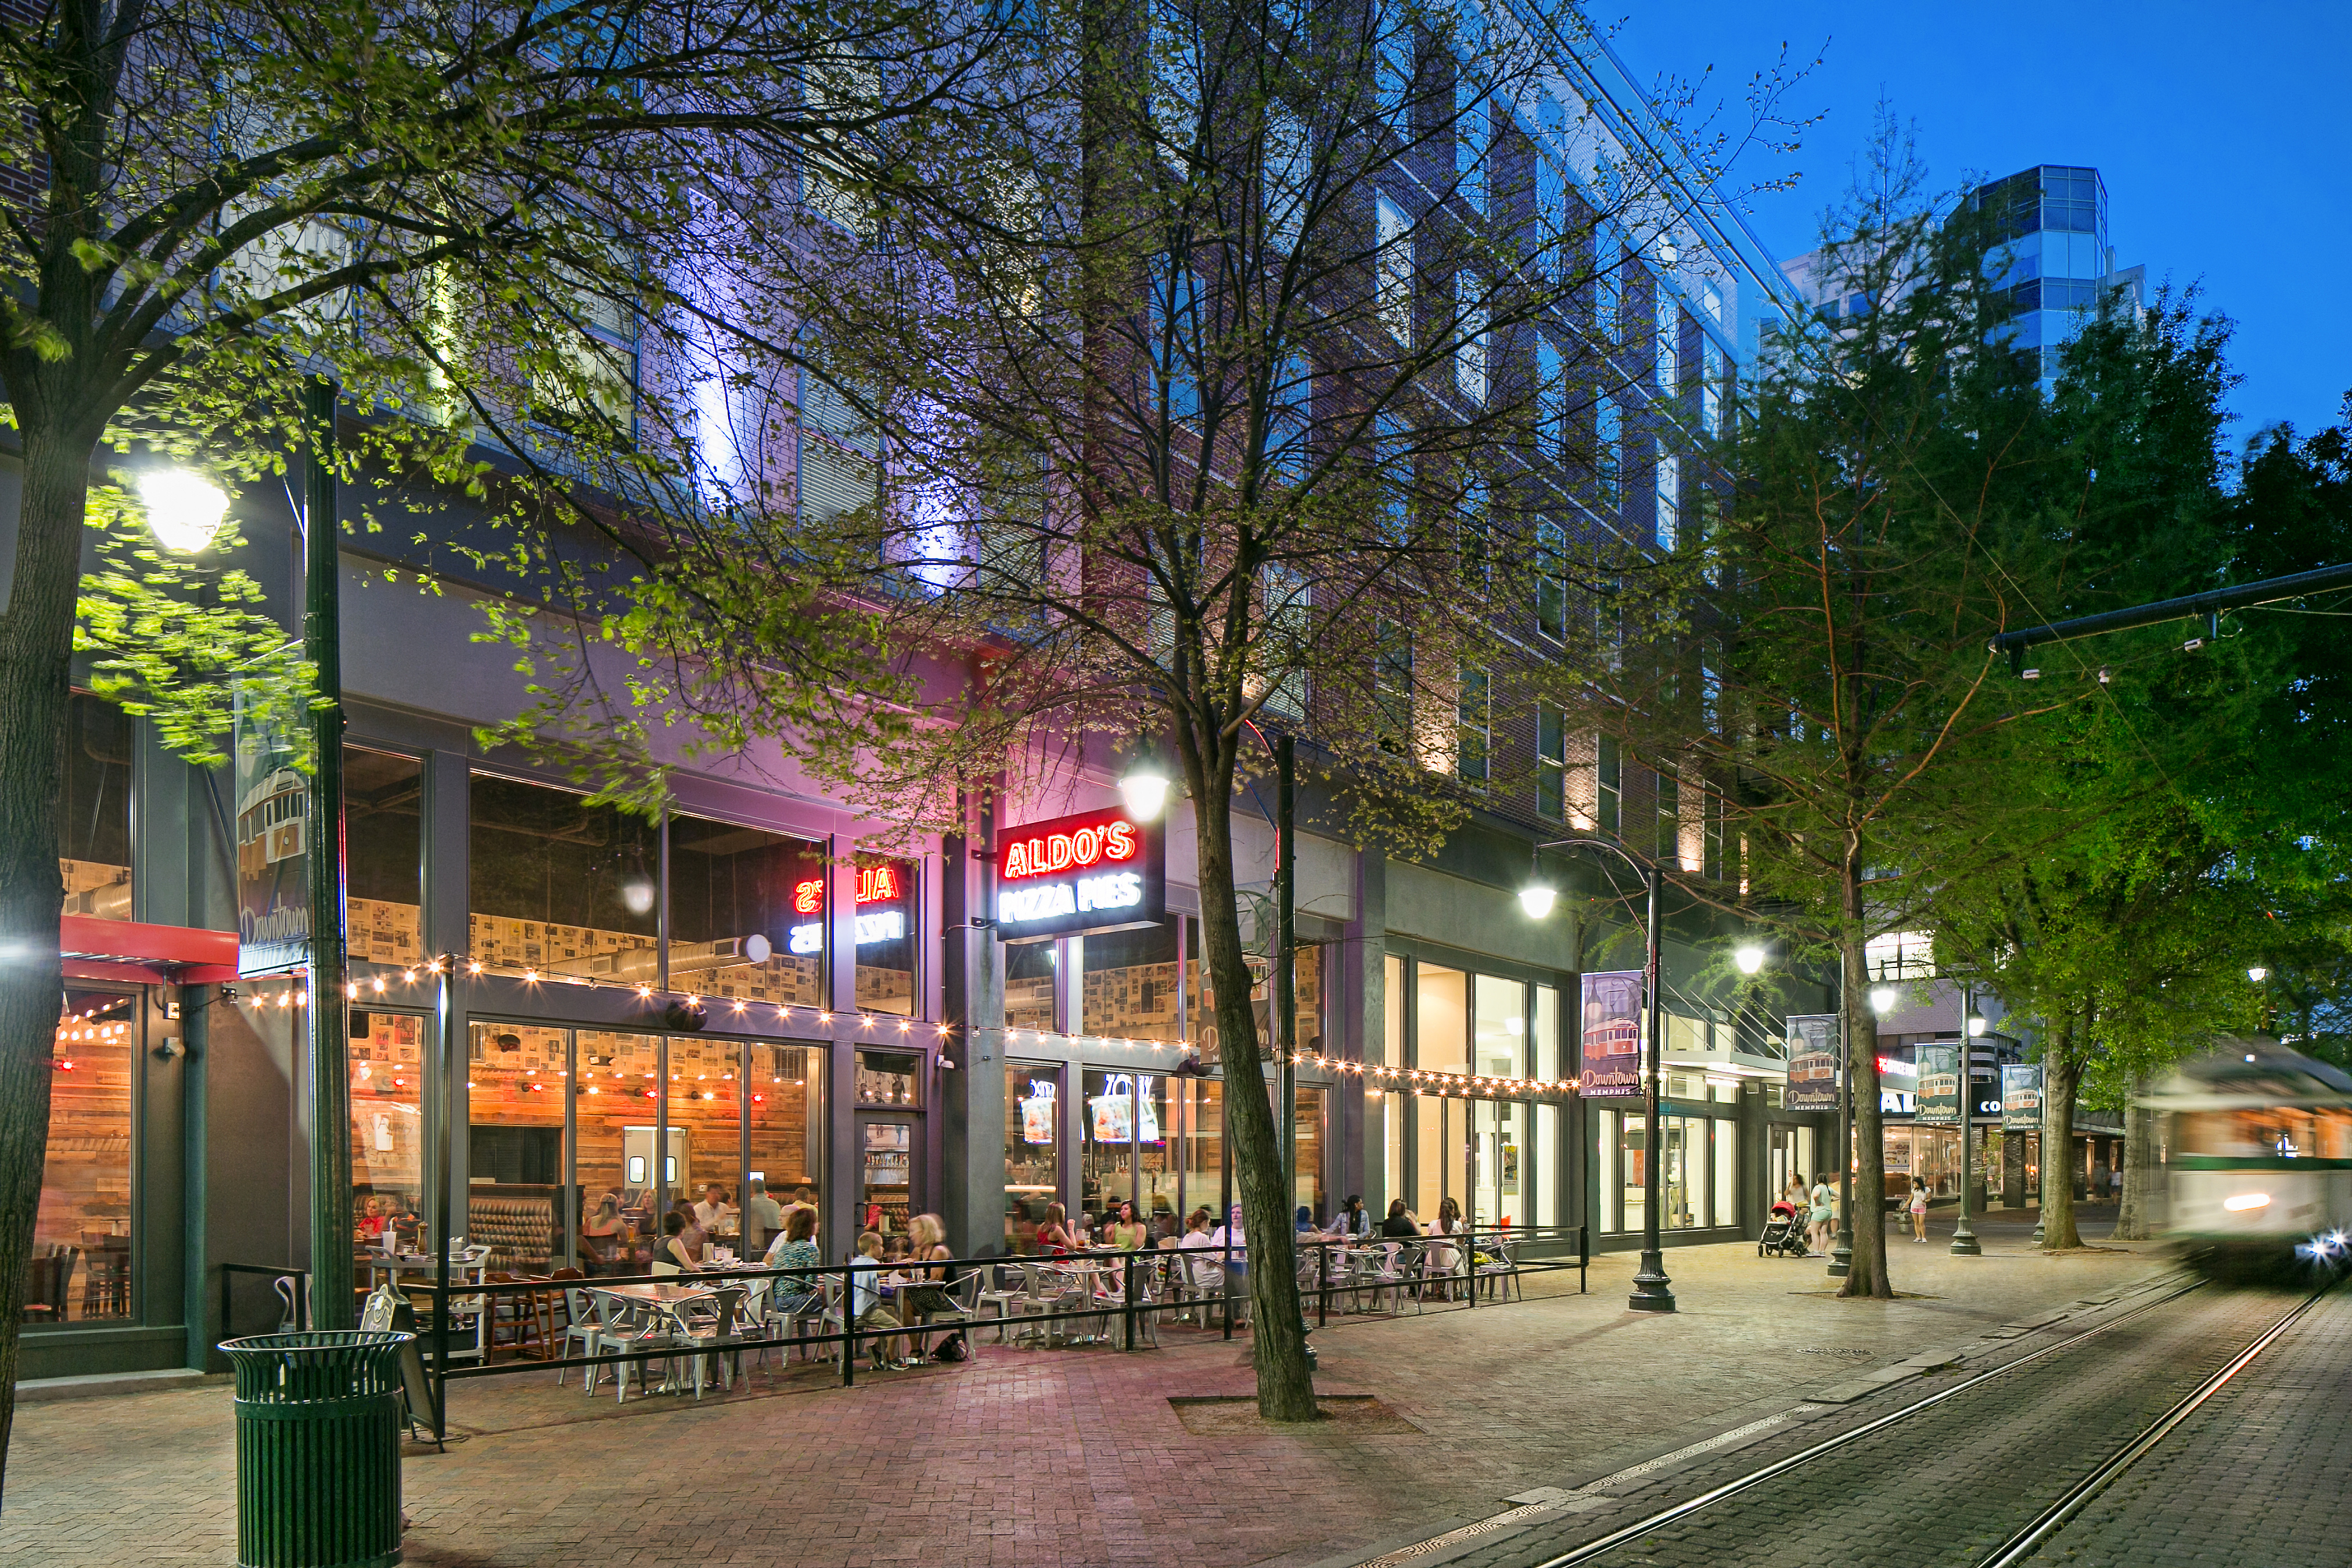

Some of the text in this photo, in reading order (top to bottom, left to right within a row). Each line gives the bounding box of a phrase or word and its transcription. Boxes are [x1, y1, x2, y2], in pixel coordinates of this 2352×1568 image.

[1005, 821, 1135, 879] ALDO'S
[999, 872, 1141, 923] PIZZA PIES
[240, 893, 309, 945] Downtown
[1583, 1066, 1638, 1087] Downtown
[1789, 1088, 1834, 1104] Downtown
[1880, 1093, 1916, 1113] AL
[1917, 1102, 1957, 1116] Downtown
[1980, 1101, 2002, 1112] CO
[2004, 1113, 2039, 1125] Downtown
